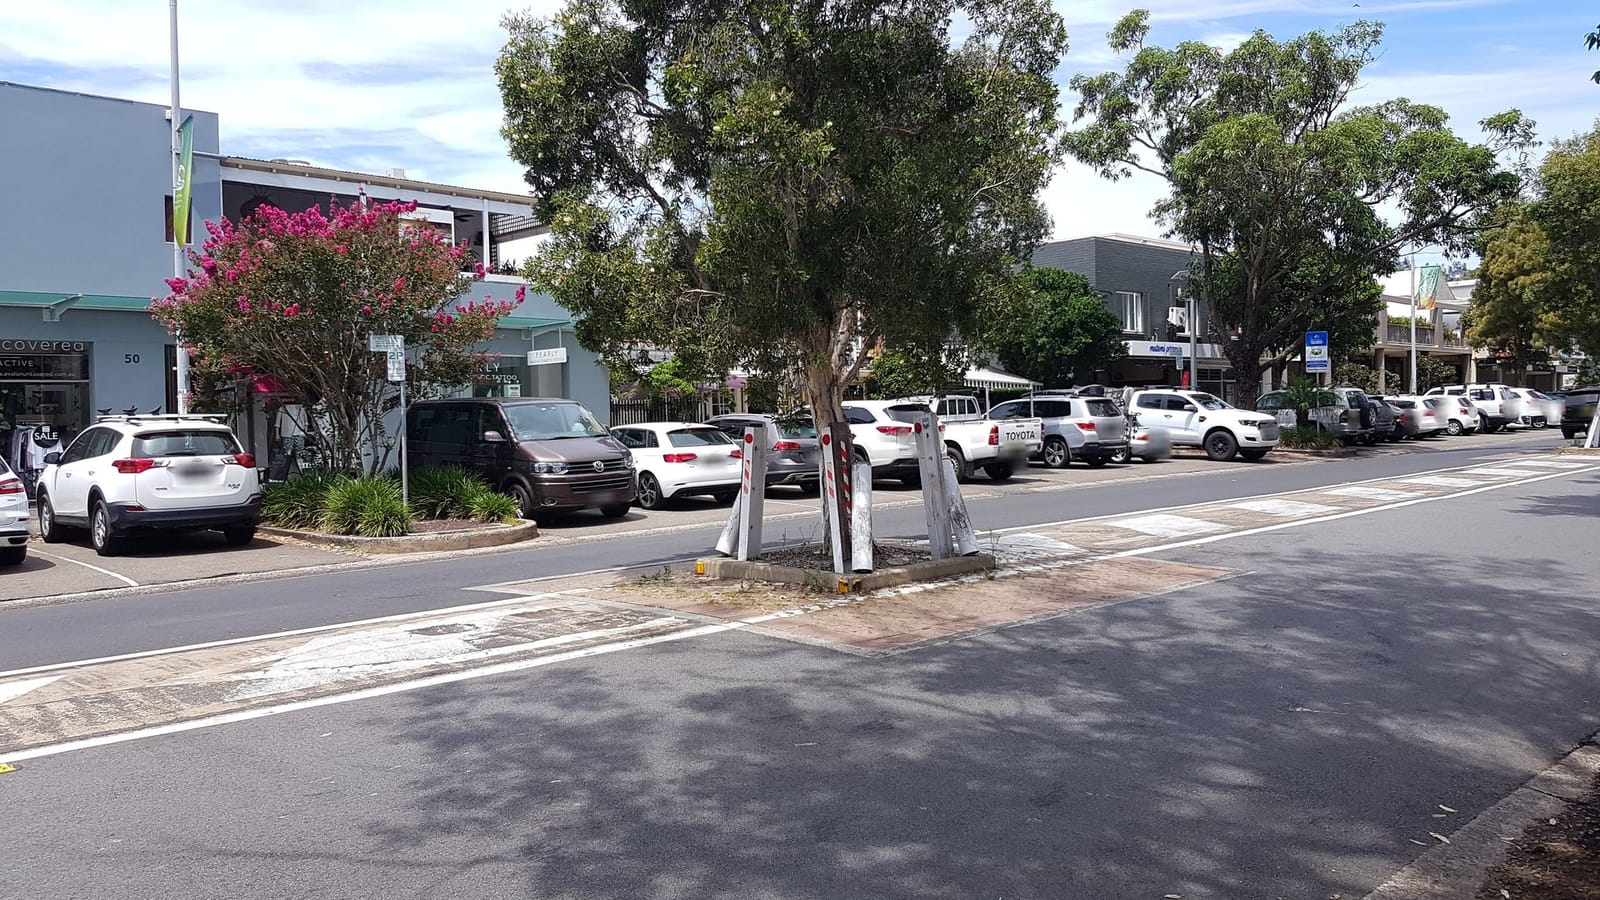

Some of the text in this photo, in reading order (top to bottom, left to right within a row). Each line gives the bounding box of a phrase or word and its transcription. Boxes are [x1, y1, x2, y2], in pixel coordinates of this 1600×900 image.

[124, 353, 140, 364] 50
[388, 351, 404, 360] 2P
[535, 351, 559, 359] PEARLY
[34, 431, 59, 441] SALE
[1005, 431, 1035, 440] TOYOTA
